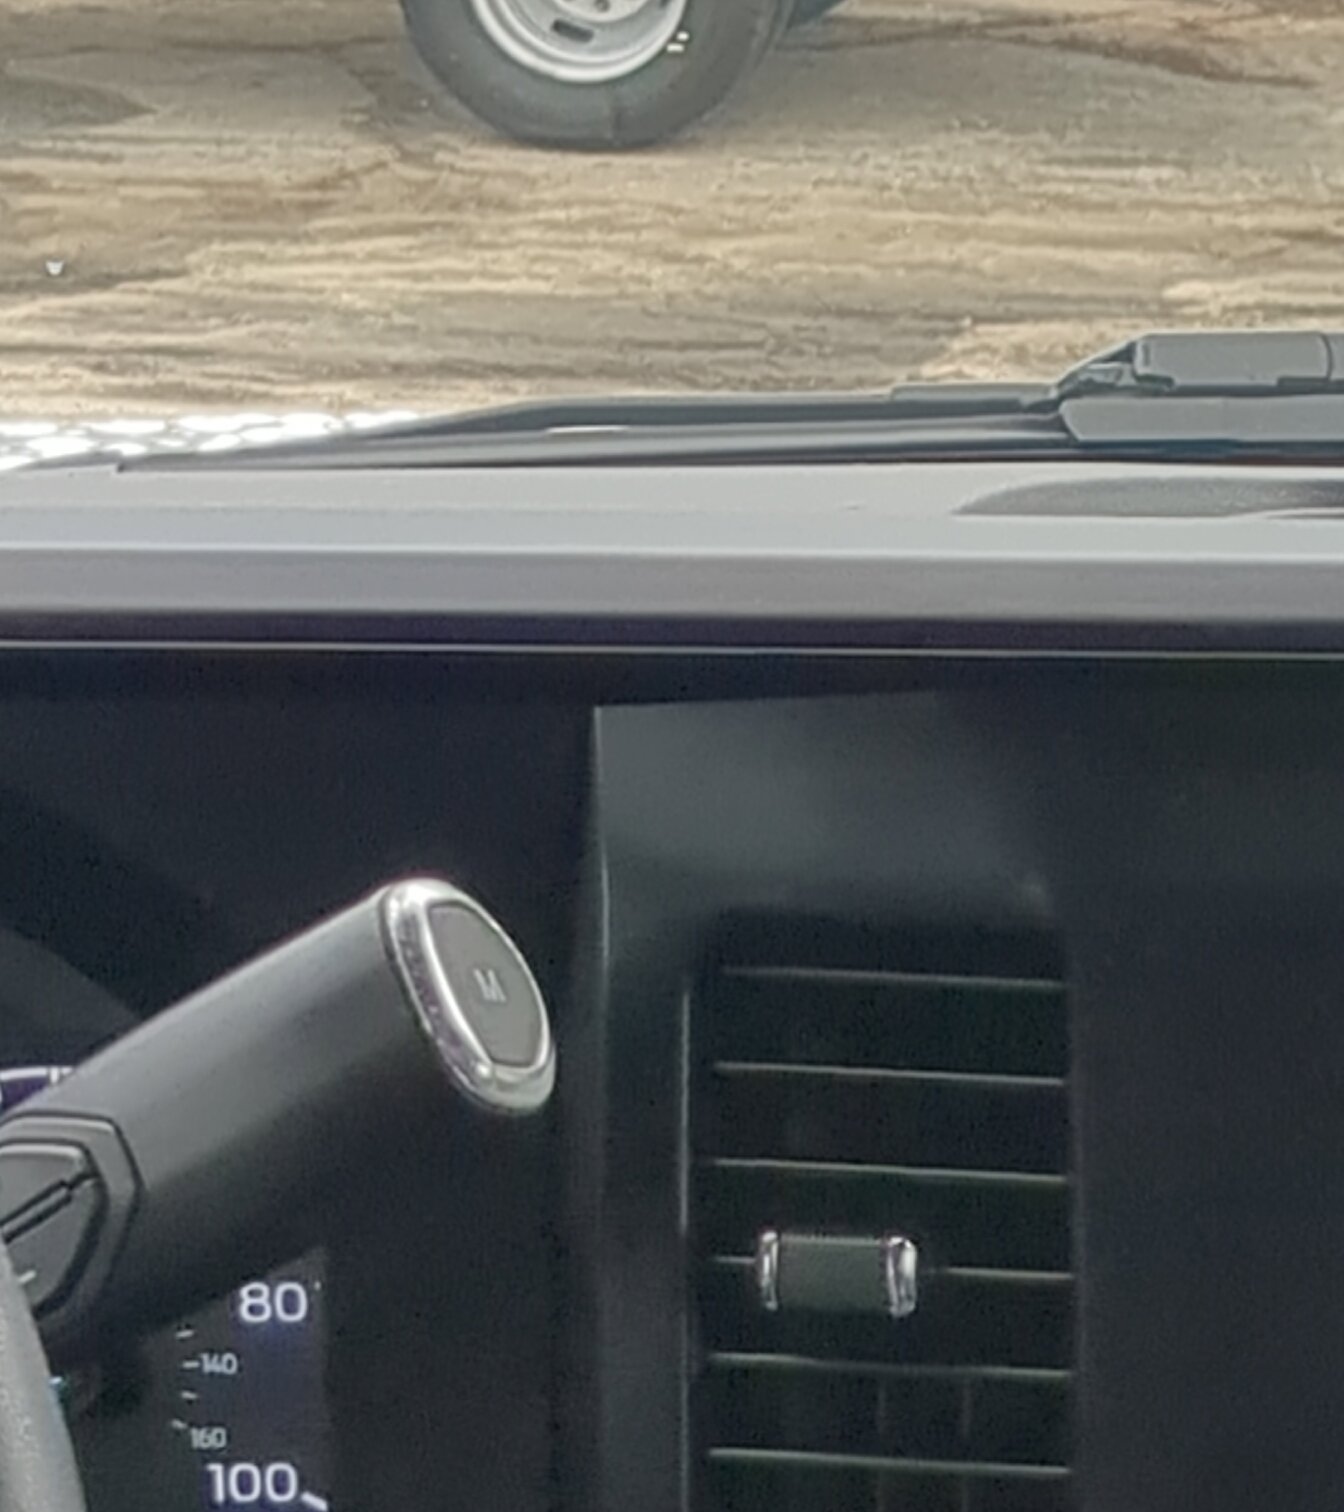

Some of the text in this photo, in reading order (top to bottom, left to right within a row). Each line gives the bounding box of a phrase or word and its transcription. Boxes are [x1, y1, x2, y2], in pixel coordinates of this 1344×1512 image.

[239, 1281, 308, 1323] 80
[201, 1352, 239, 1375] 140
[190, 1426, 228, 1449] 160
[206, 1461, 298, 1504] 100
